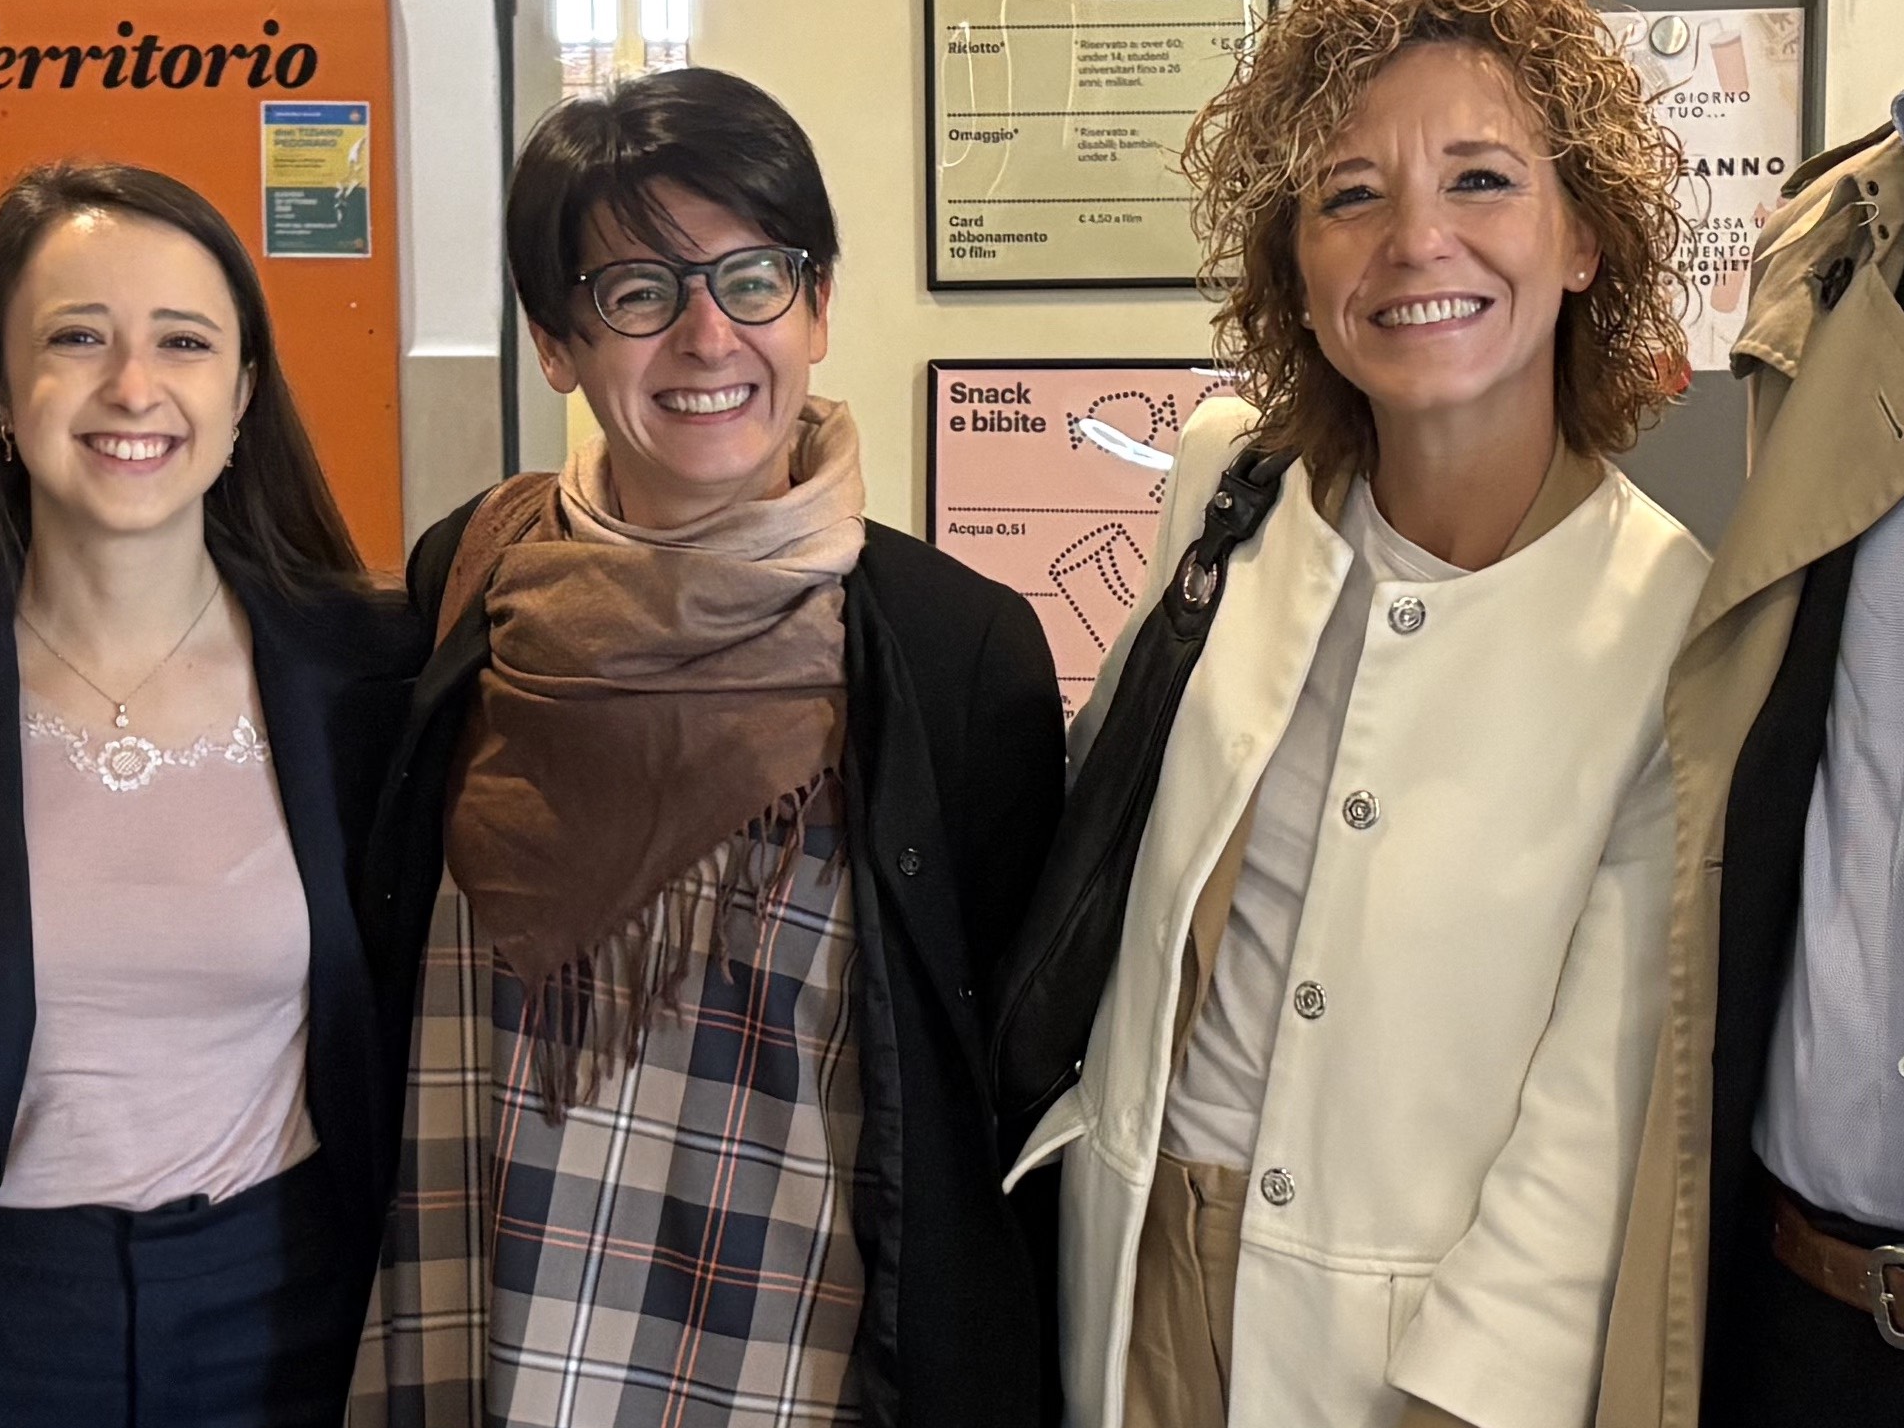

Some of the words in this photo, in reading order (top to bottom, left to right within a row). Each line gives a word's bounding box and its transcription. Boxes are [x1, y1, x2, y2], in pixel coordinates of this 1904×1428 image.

[1674, 91, 1751, 105] GIORNO
[1667, 106, 1726, 118] TUO...
[948, 214, 984, 228] Card
[949, 230, 1048, 244] abbonamento
[1730, 232, 1748, 243] DI
[950, 246, 966, 260] 10
[969, 245, 997, 260] film
[950, 382, 1031, 405] Snack
[950, 416, 966, 432] e
[972, 410, 1046, 433] bibite
[948, 523, 994, 537] Acqua
